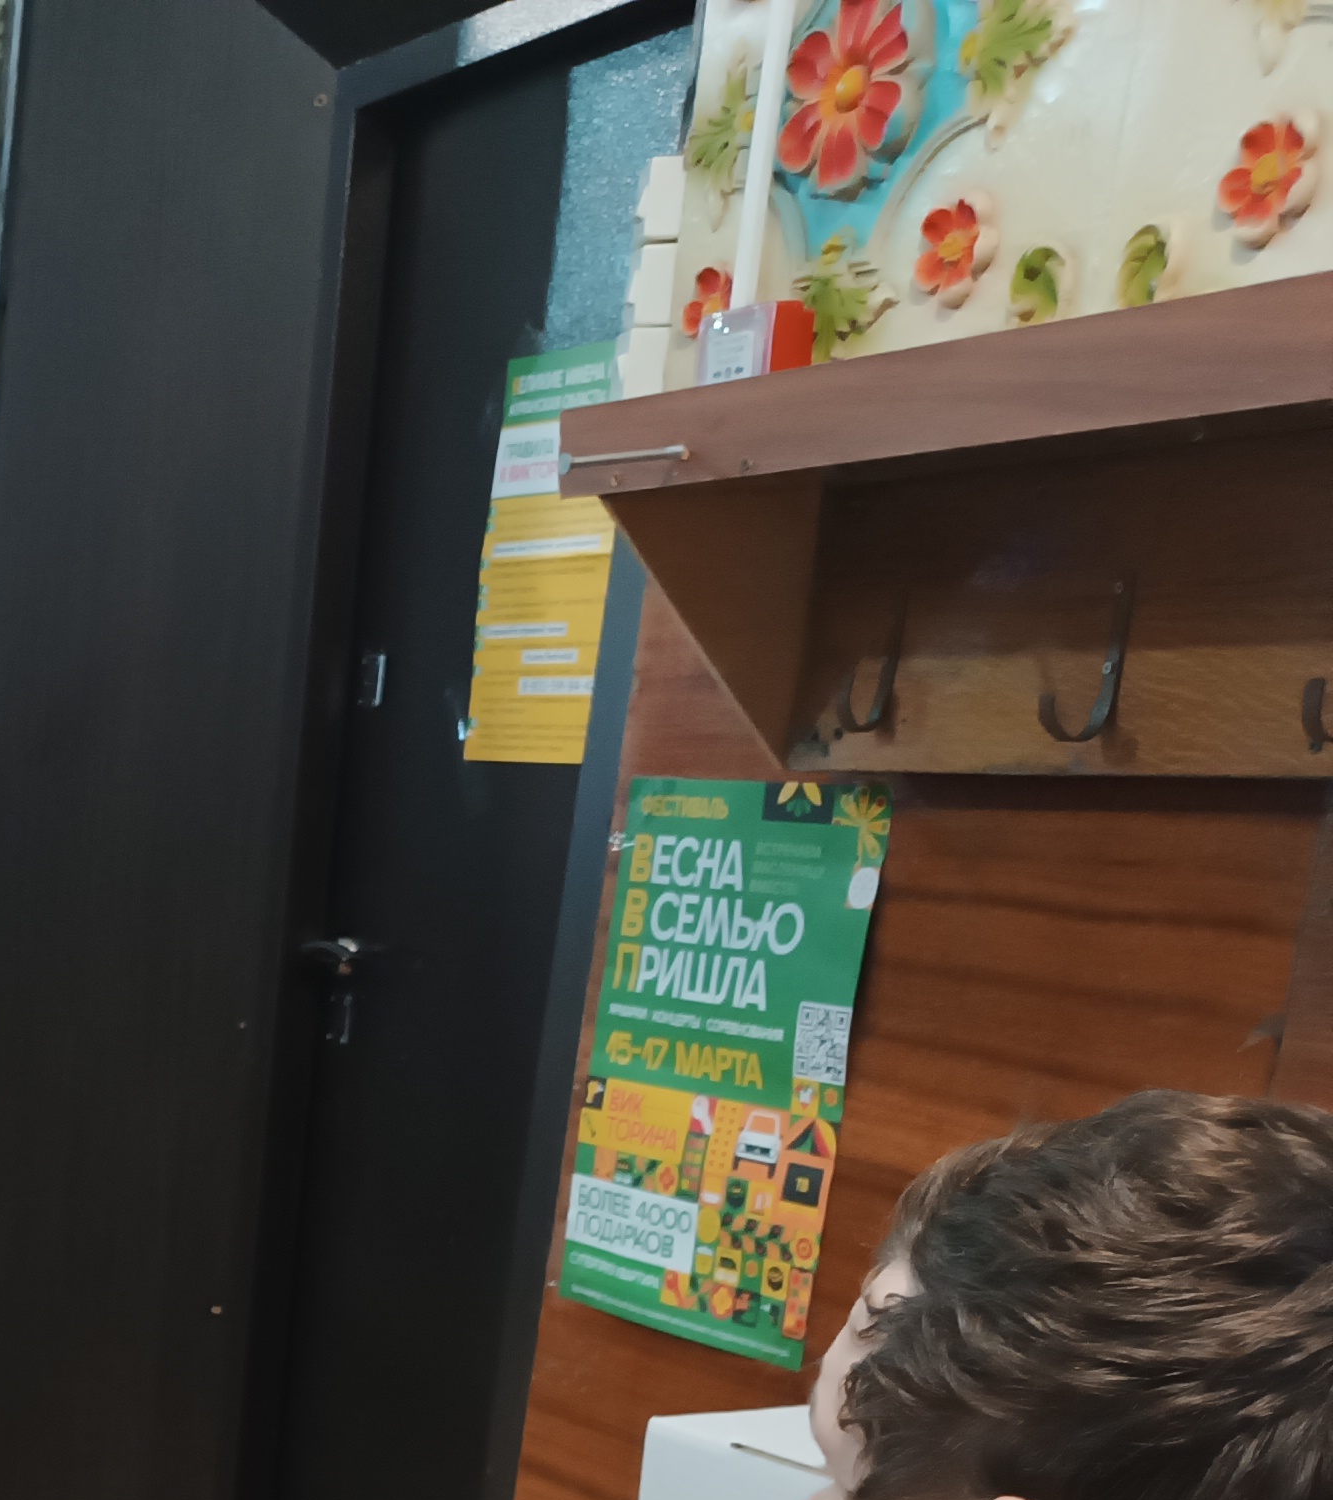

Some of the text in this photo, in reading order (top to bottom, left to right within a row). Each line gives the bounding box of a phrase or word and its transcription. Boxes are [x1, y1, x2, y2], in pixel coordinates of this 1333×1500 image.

[629, 833, 743, 891] ВЕСНА
[621, 888, 805, 956] В СЕМЬЮ
[612, 942, 768, 1011] ПРИШЛА
[605, 1030, 764, 1090] 15-17 МАРТА
[609, 1088, 644, 1118] ВИК
[607, 1116, 679, 1152] ТОРИНА
[574, 1211, 676, 1259] ПОДАРКОВ
[577, 1184, 693, 1234] БОЛЕЕ 4000
